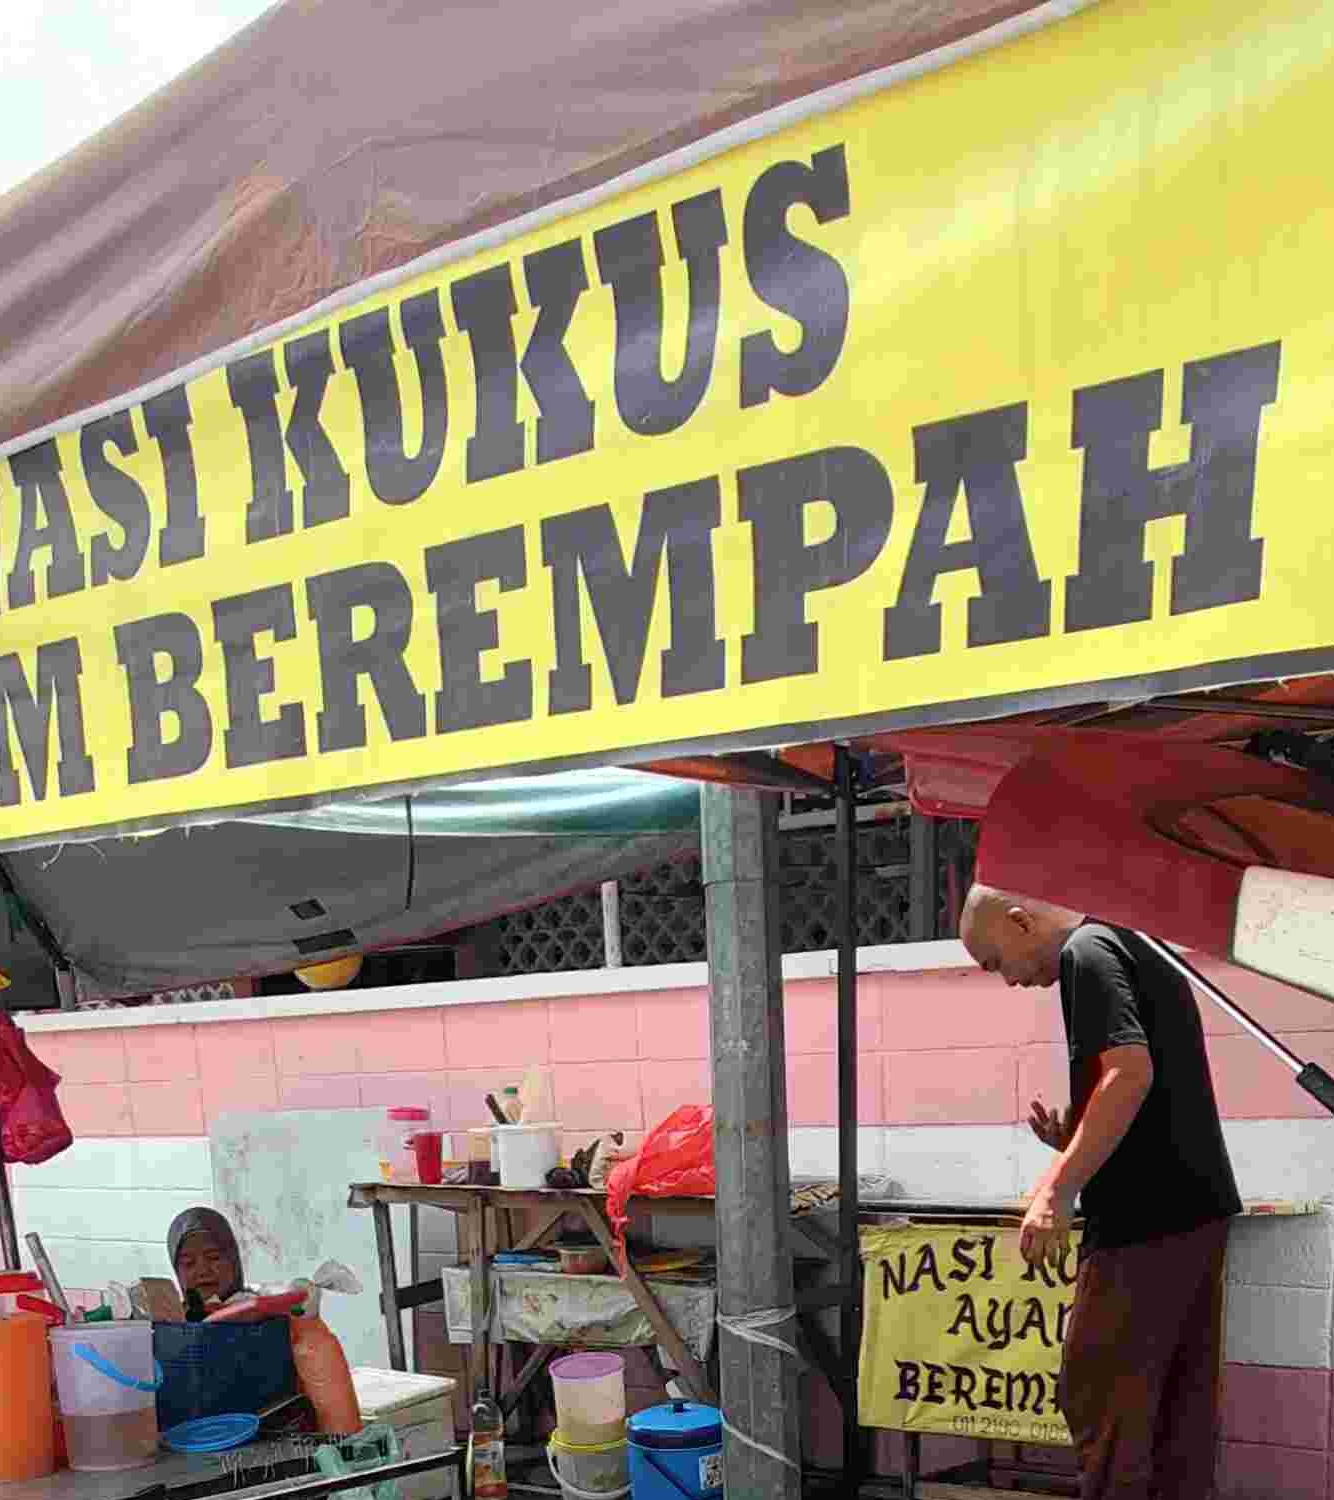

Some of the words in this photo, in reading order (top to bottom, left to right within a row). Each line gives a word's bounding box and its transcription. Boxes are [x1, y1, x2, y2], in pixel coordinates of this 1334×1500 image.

[226, 142, 851, 545] KUKUS
[113, 339, 1282, 786] BEREMPAH
[879, 1233, 995, 1300] NASI
